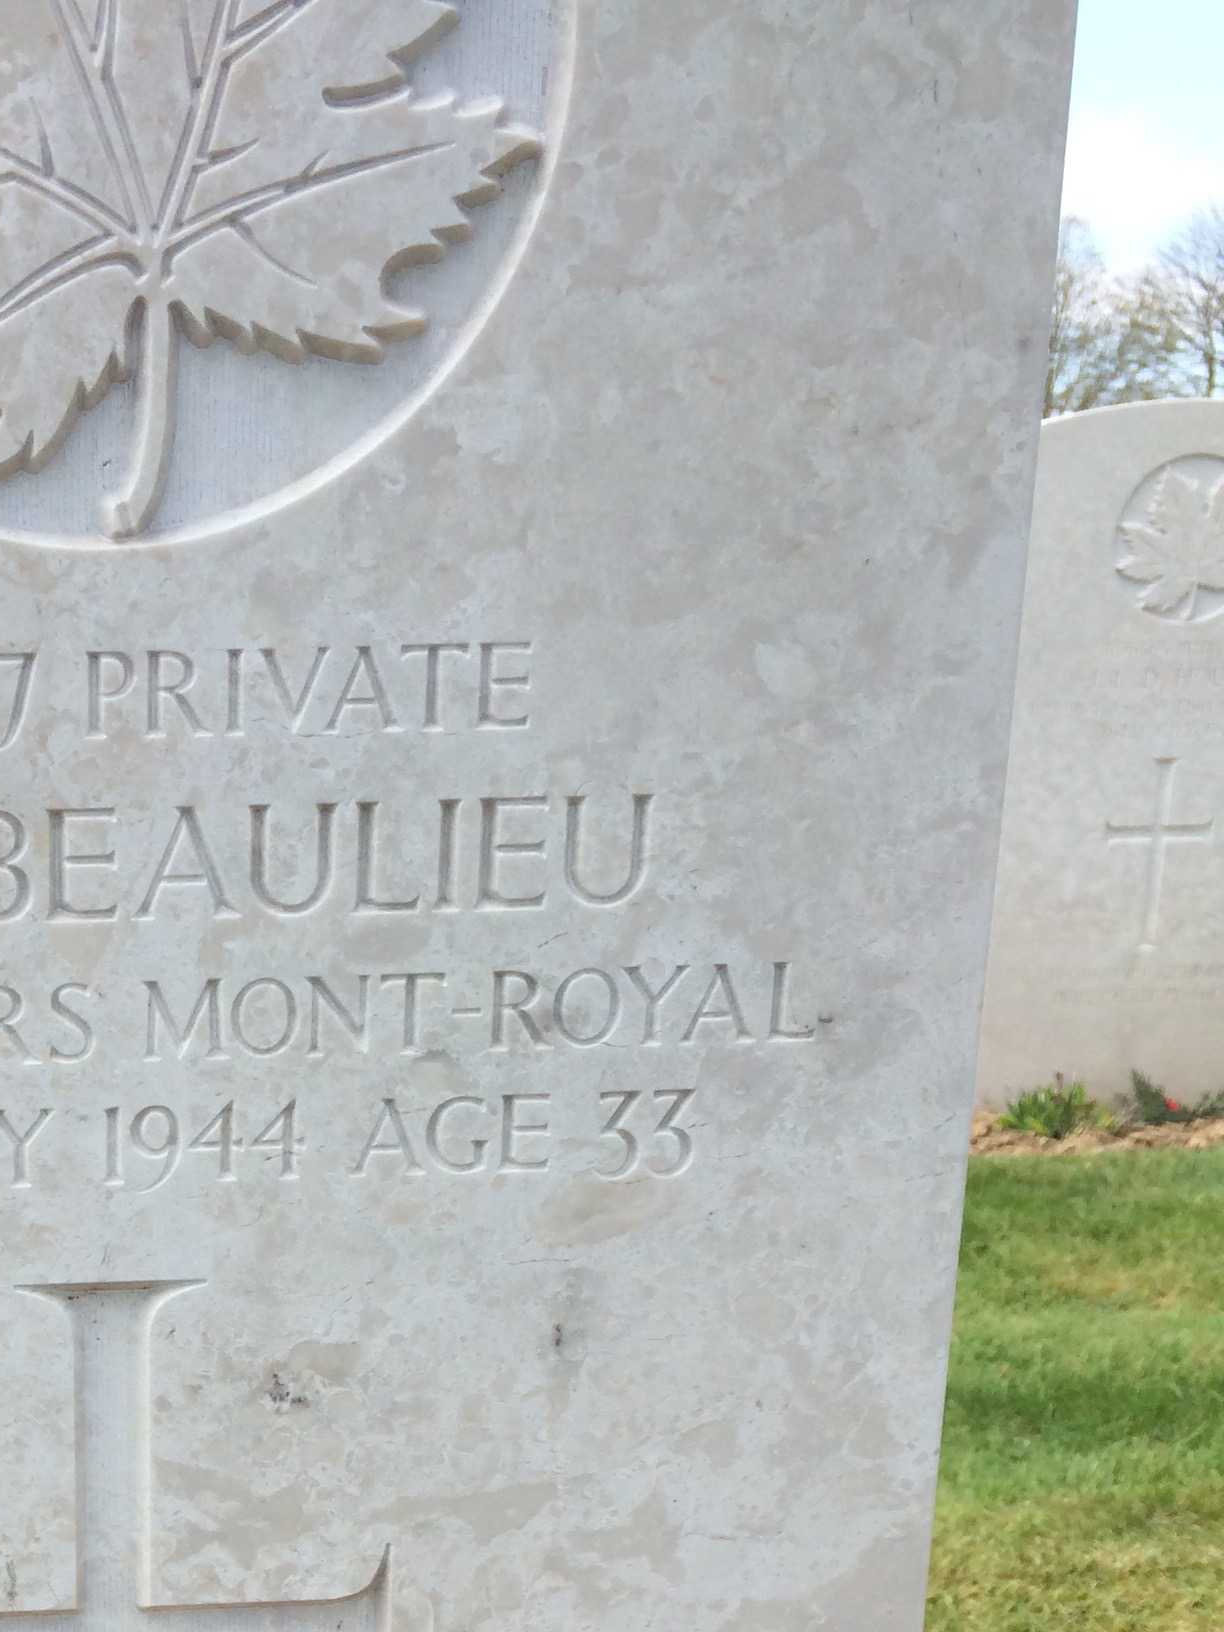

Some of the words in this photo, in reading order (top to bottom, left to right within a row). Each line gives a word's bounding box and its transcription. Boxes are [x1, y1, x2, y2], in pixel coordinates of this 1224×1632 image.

[86, 640, 533, 740] PRIVATE
[142, 961, 817, 1062] MONT-ROYAL
[102, 1098, 307, 1194] 1944
[349, 1093, 551, 1176] AGE
[591, 1087, 697, 1180] 33
